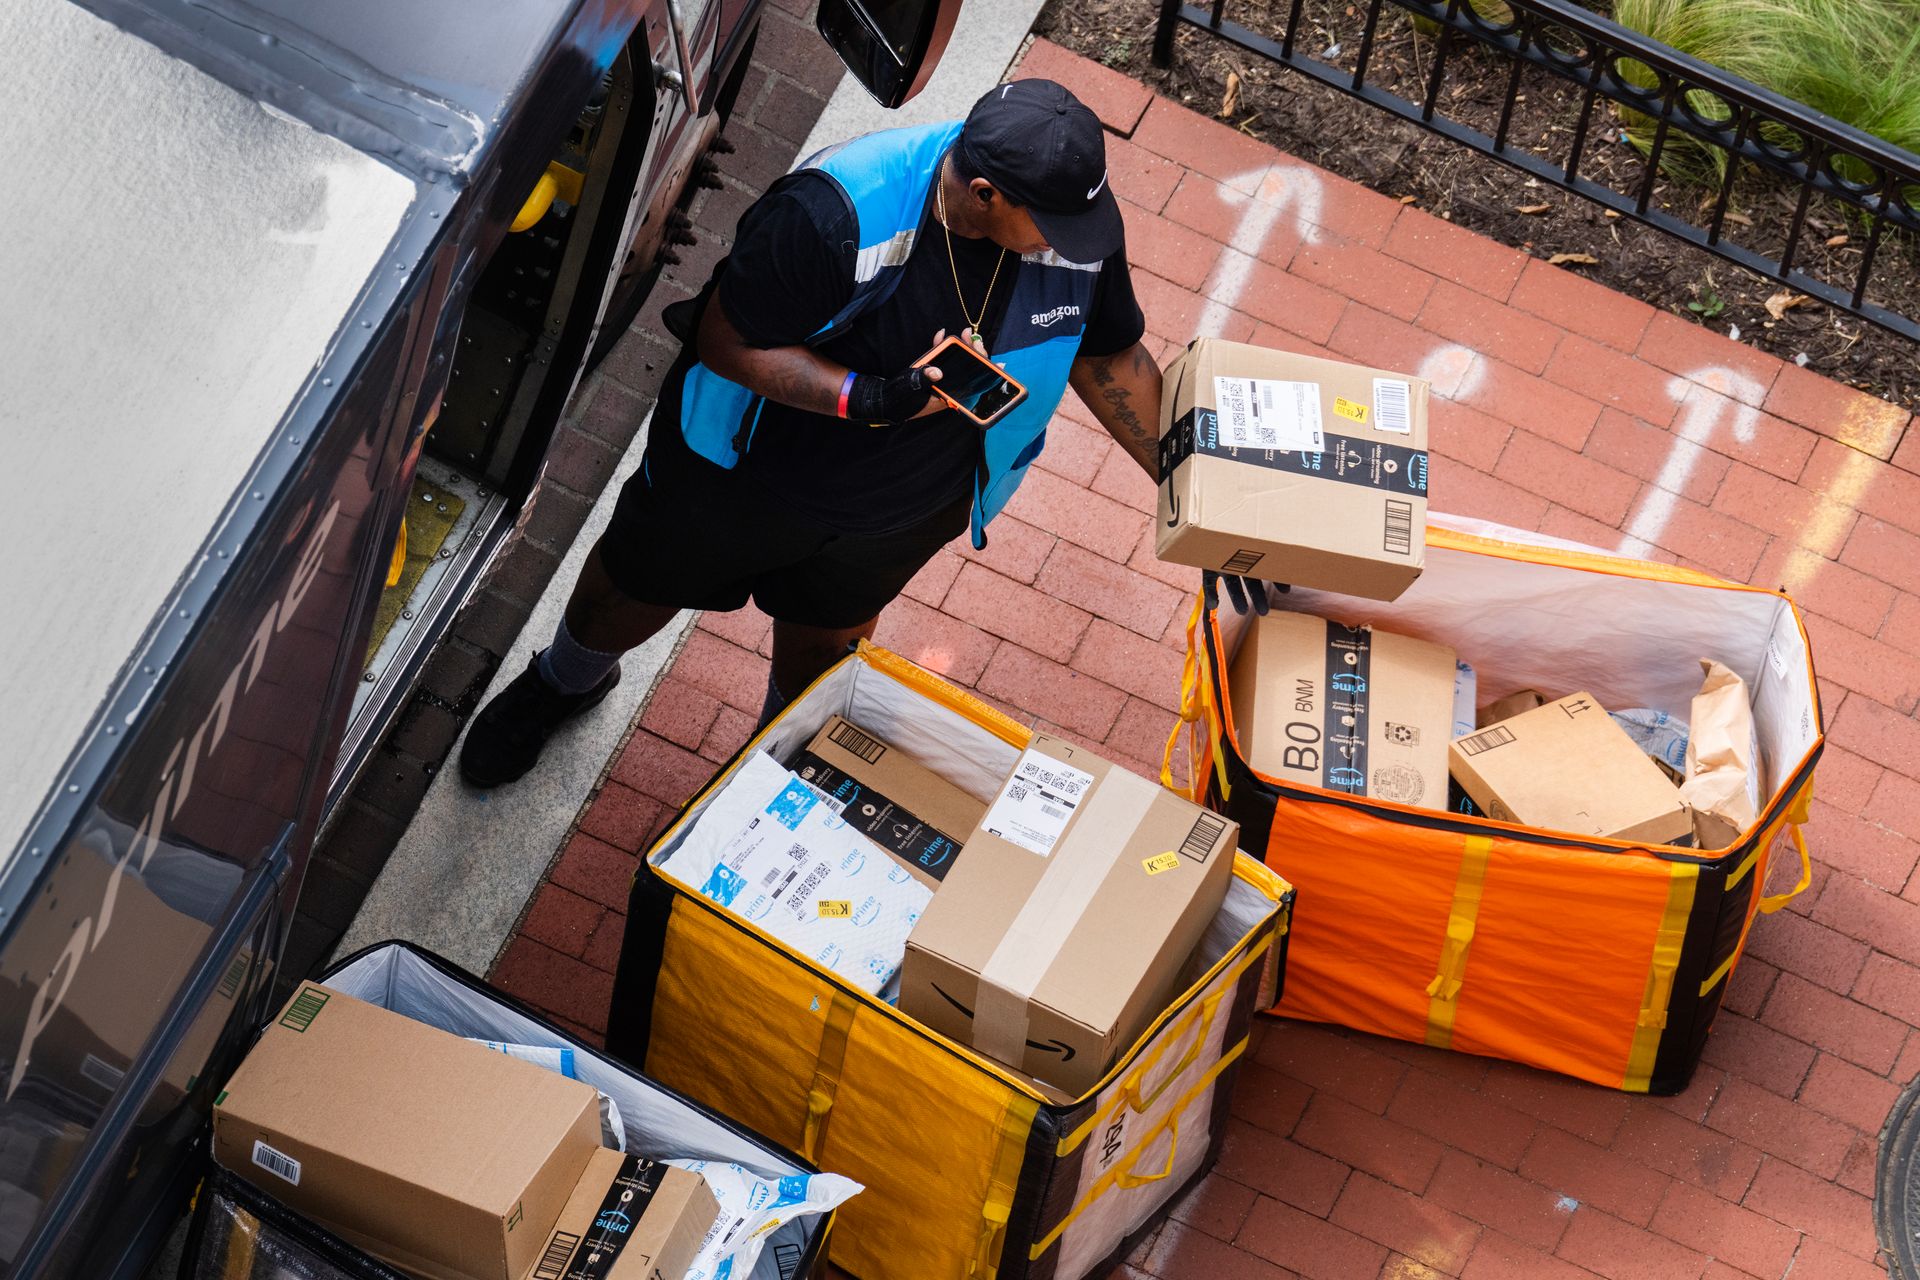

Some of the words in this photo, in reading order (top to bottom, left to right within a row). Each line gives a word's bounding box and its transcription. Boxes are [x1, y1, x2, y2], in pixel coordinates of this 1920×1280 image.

[1031, 305, 1080, 325] amazon
[1355, 407, 1364, 419] K
[1206, 413, 1218, 450] prime
[1338, 452, 1346, 476] listening
[1417, 454, 1428, 490] prime
[1295, 679, 1313, 713] BNM
[1332, 681, 1366, 694] prime
[833, 779, 853, 800] rime
[1330, 775, 1363, 787] prime
[6, 500, 340, 1102] prime
[876, 803, 894, 822] streaming
[897, 839, 908, 850] free
[905, 823, 923, 841] listening
[919, 836, 945, 866] prime
[1147, 861, 1157, 871] K
[744, 894, 767, 920] prim
[840, 904, 848, 915] K
[850, 895, 876, 926] prime
[754, 1184, 770, 1211] rime
[596, 1218, 630, 1233] prime
